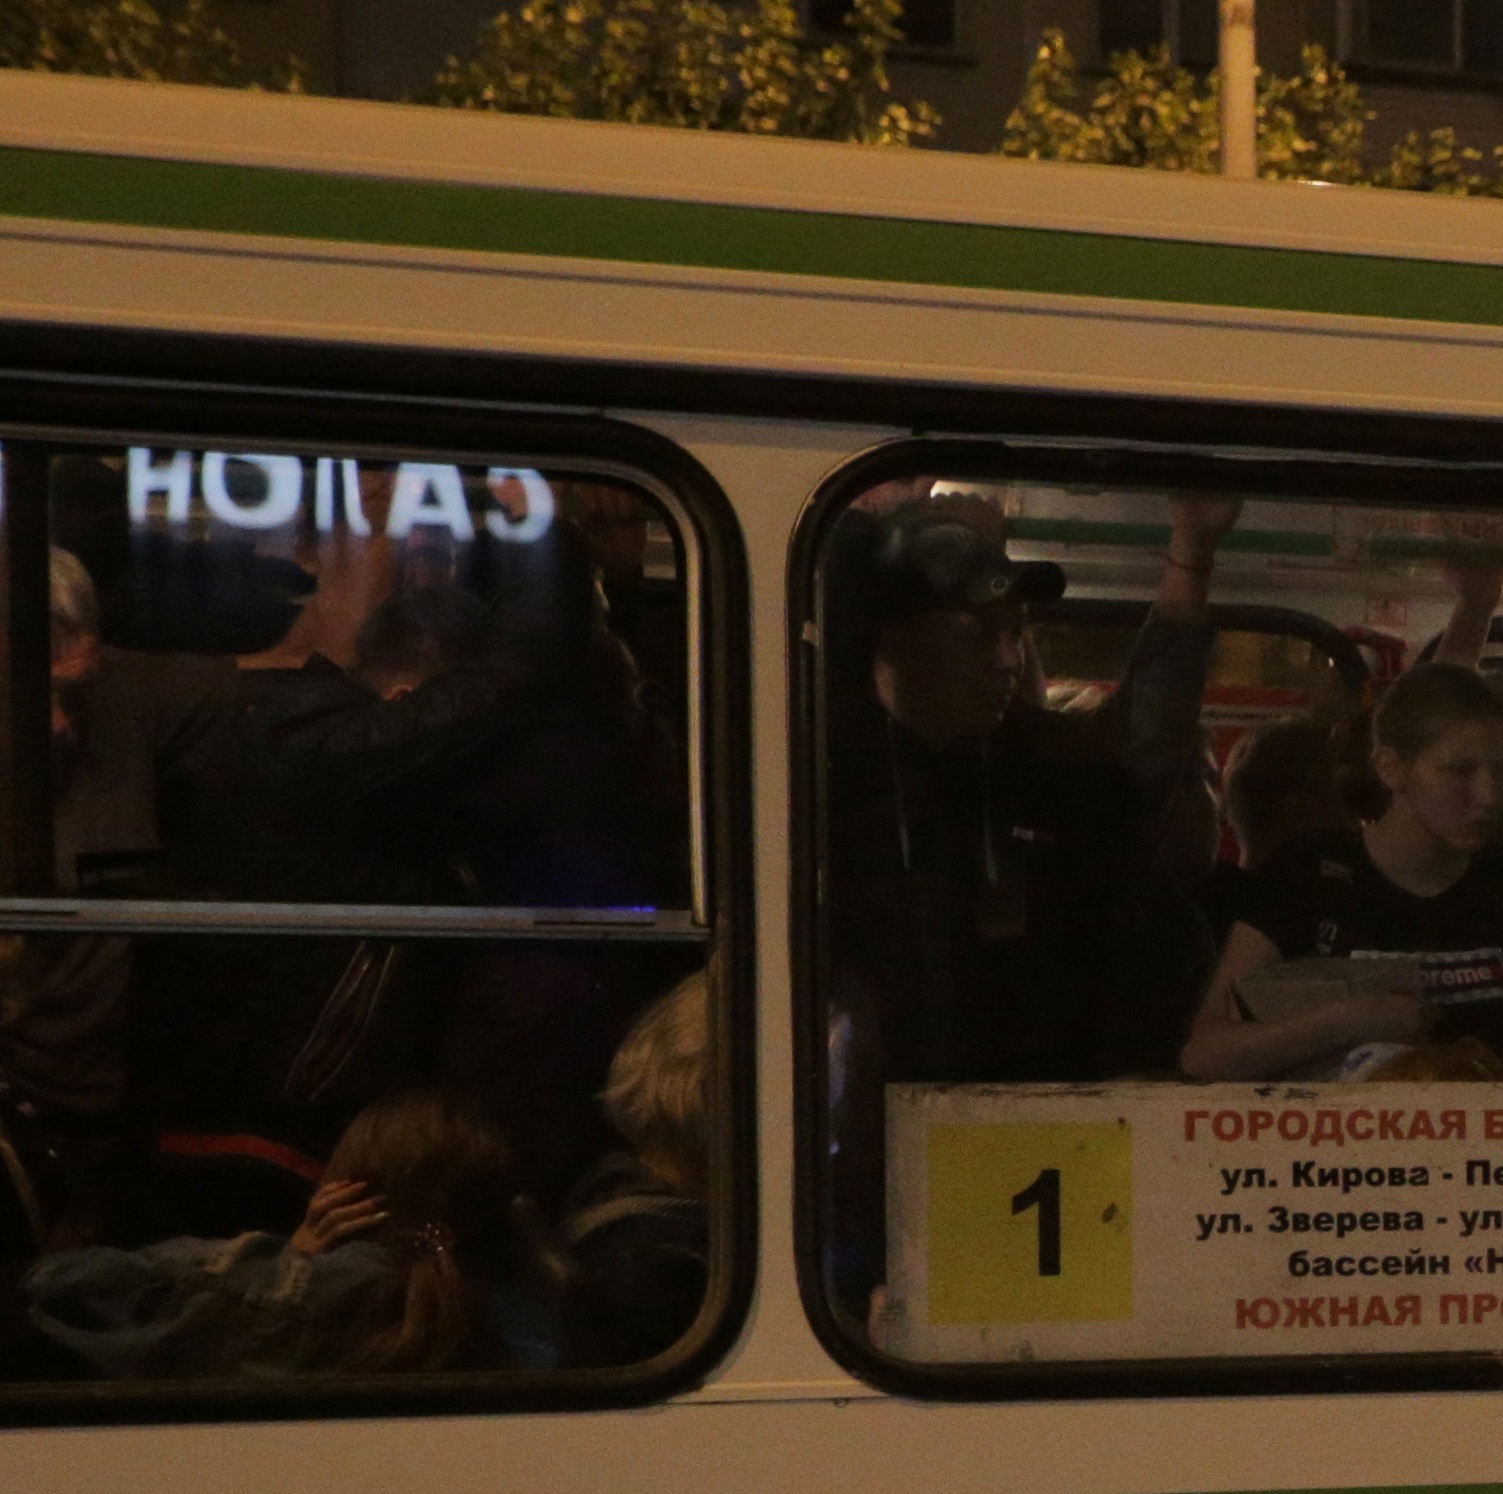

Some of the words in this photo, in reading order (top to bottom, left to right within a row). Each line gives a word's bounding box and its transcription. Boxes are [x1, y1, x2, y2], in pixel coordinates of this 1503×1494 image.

[1418, 965, 1492, 988] preme
[1185, 1109, 1467, 1147] ГОРОДСКАЯ
[1220, 1167, 1278, 1196] ул.
[1291, 1160, 1430, 1193] Кирова
[1010, 1168, 1062, 1277] 1
[1196, 1212, 1253, 1242] ул.
[1268, 1205, 1425, 1239] Зверева
[1287, 1247, 1450, 1278] бассейн
[1236, 1294, 1421, 1329] ЮЖНАЯ
